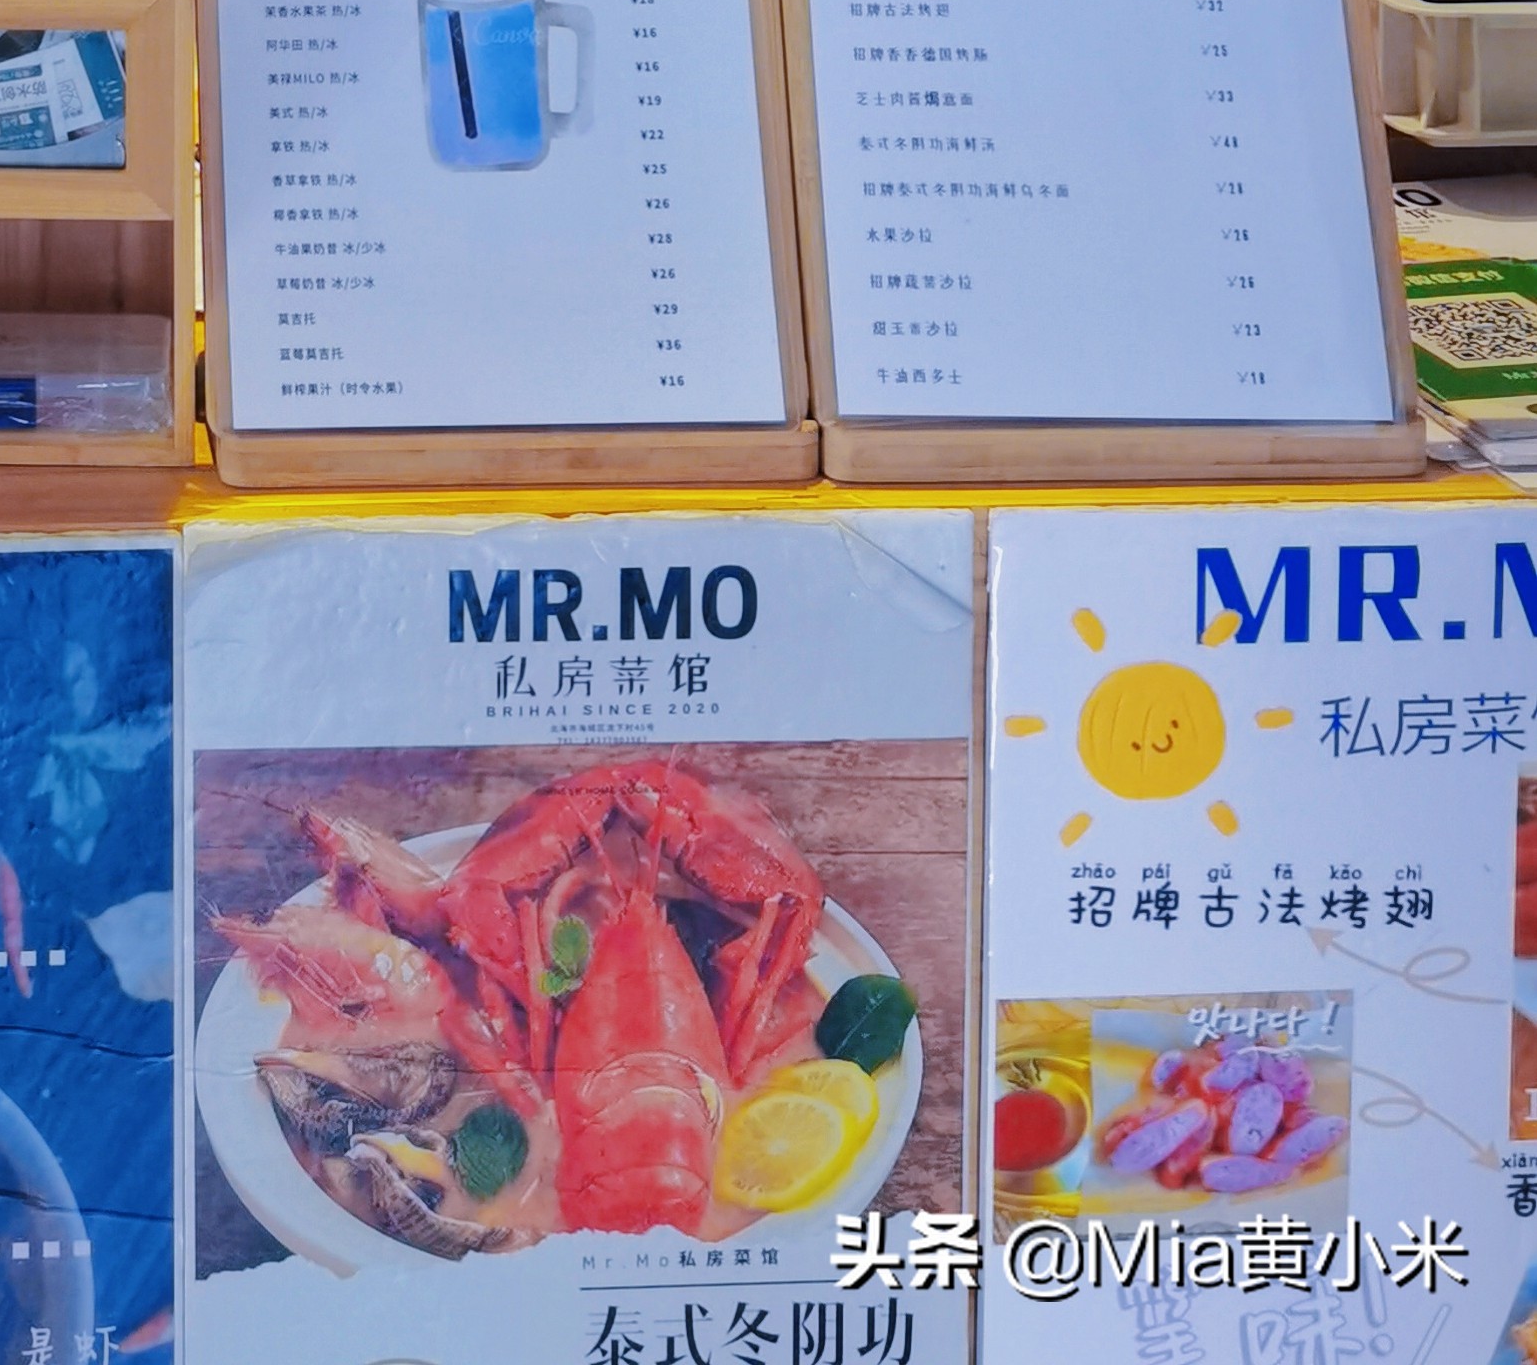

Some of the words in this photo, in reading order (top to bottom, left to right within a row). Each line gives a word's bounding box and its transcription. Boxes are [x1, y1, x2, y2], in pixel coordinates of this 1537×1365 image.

[851, 3, 949, 17] 招牌古法烤翅
[266, 39, 303, 51] 阿华田
[270, 107, 293, 118] 美式
[271, 141, 294, 153] 拿铁
[272, 174, 321, 187] 香草拿铁
[867, 228, 931, 243] 水果沙拉
[275, 243, 336, 255] 牛油果奶昔
[277, 278, 325, 290] 草莓奶昔
[278, 313, 315, 325] 莫吉托
[280, 348, 344, 360] 蓝莓莫吉托
[447, 565, 758, 643] MR.MO
[494, 652, 712, 699] 私房菜馆
[486, 706, 567, 717] BRIHAI
[583, 704, 653, 716] SINCE
[668, 703, 721, 714] 2020
[1319, 692, 1537, 759] 私房菜
[1069, 882, 1434, 929] 招牌古法烤翅
[582, 1297, 916, 1365] 泰式冬阴功
